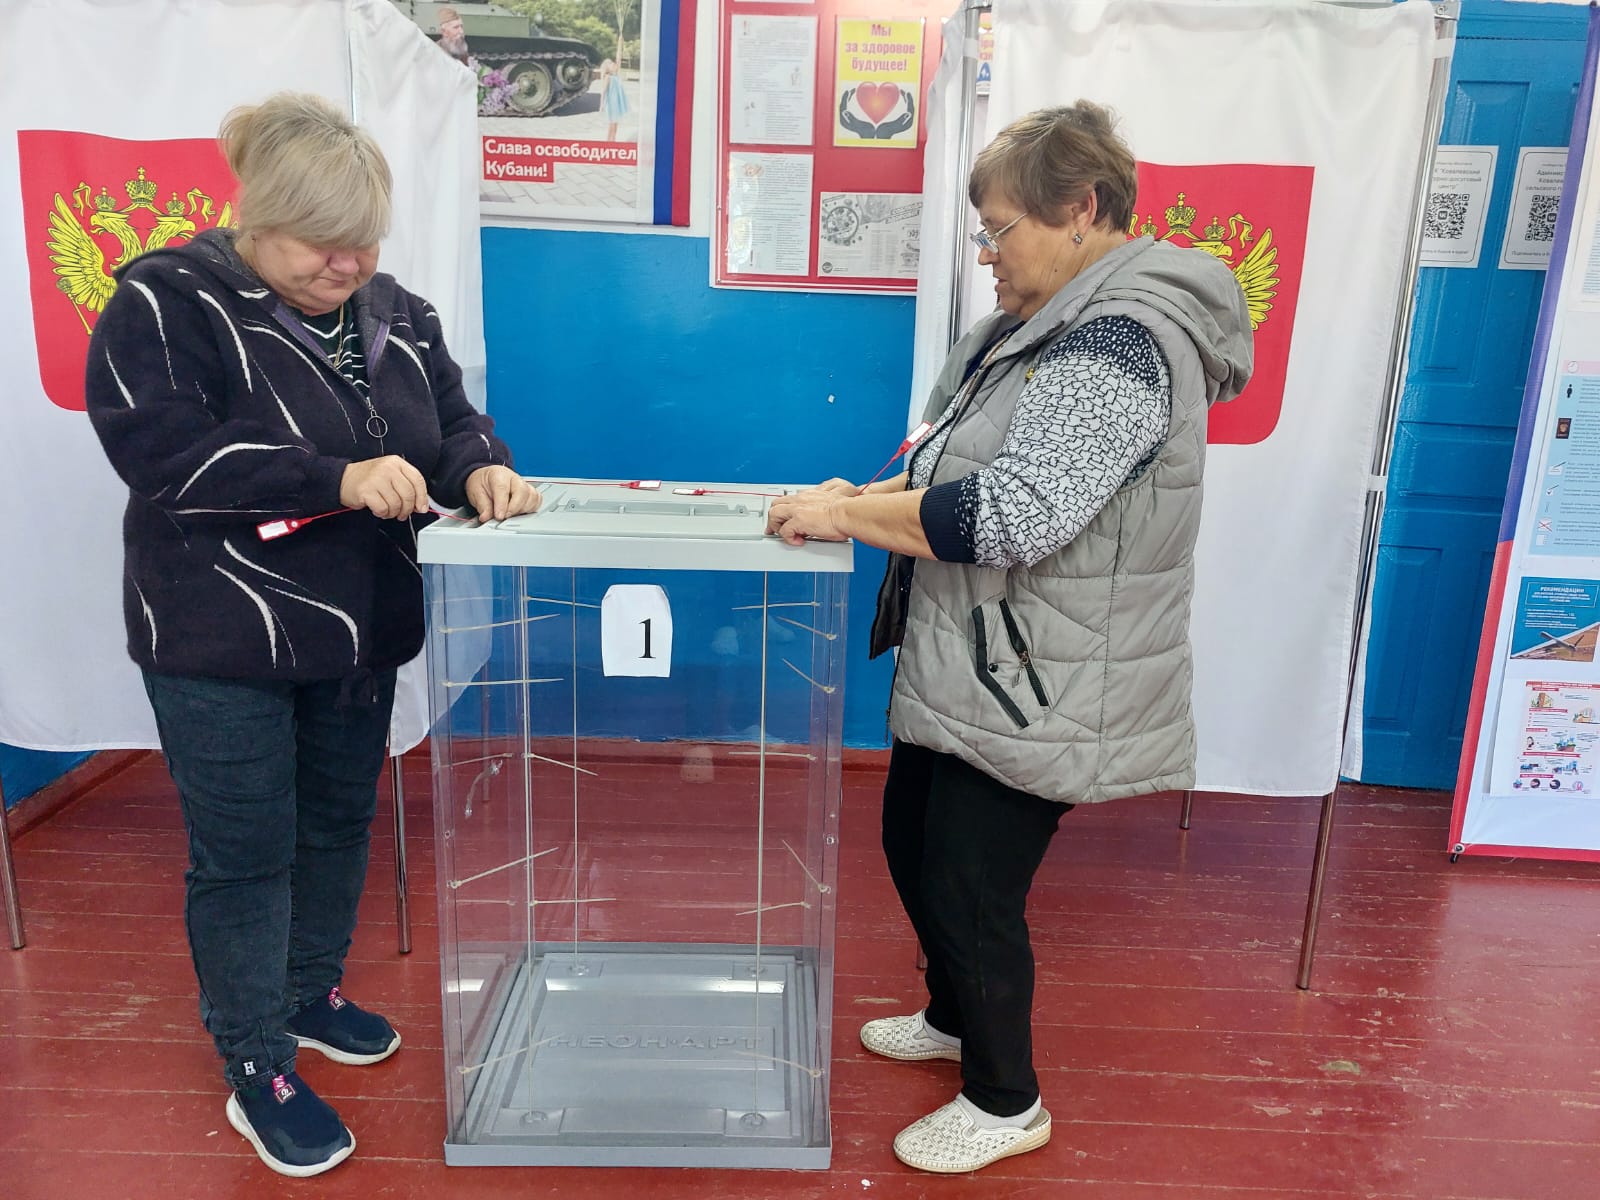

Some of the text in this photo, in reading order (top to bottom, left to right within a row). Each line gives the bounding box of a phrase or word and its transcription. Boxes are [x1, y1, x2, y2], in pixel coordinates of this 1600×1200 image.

[871, 24, 891, 36] Мы
[845, 42, 915, 55] за здоровое
[852, 57, 907, 72] будущее!
[484, 139, 637, 161] Слава освободител
[485, 161, 548, 178] Кубани!
[638, 618, 656, 659] 1
